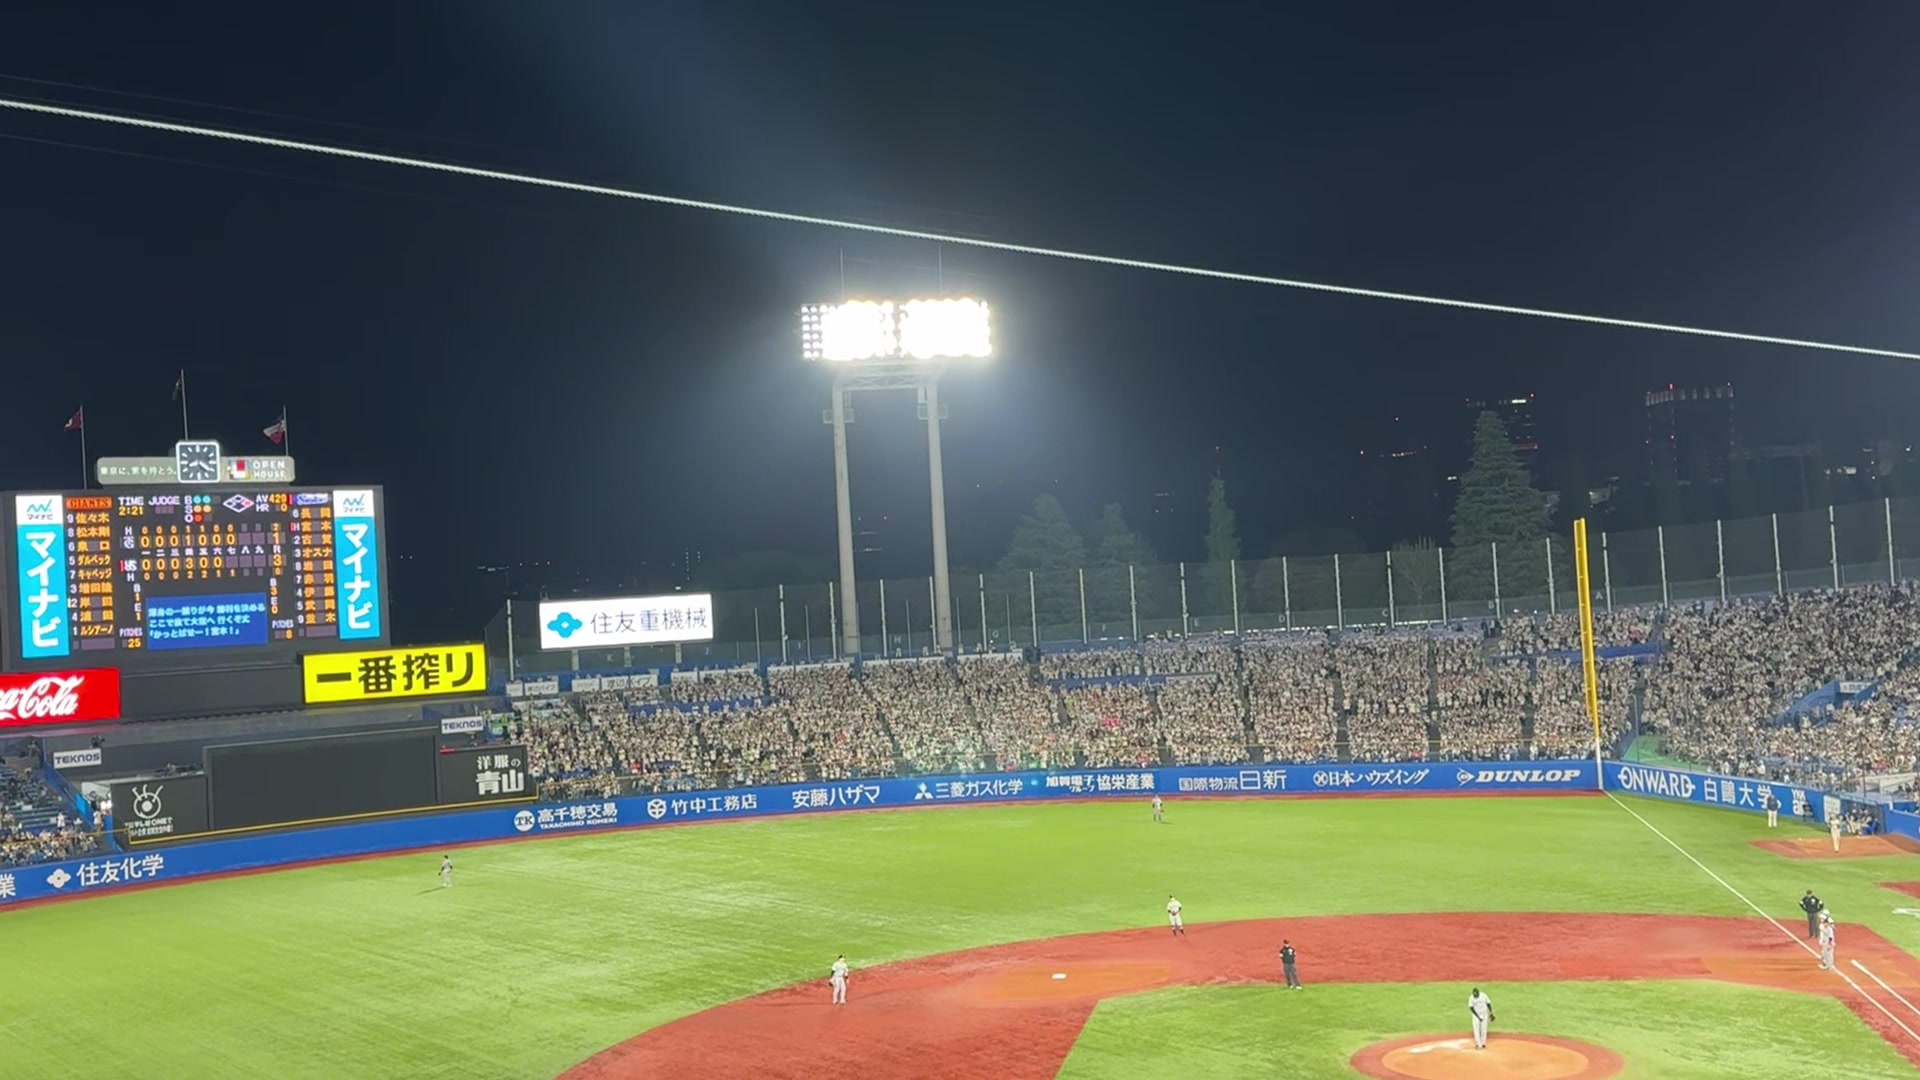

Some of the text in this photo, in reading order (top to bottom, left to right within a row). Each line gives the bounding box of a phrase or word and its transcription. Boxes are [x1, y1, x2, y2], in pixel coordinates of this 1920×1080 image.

[253, 460, 286, 469] OPEN
[253, 470, 286, 478] HOUSE
[69, 498, 109, 508] GIANTS
[118, 496, 144, 506] TIME
[148, 496, 180, 506] JUDGE
[184, 495, 193, 505] B
[256, 494, 268, 503] AV
[119, 506, 144, 516] 2:21
[256, 503, 288, 512] HR 0
[67, 514, 74, 523] 9
[292, 509, 299, 518] 6
[68, 527, 74, 537] 8
[124, 526, 132, 536] H
[141, 536, 150, 548] 0
[156, 536, 164, 547] 0
[170, 535, 178, 547] 0
[198, 534, 206, 546] 0
[212, 534, 220, 546] 0
[226, 534, 235, 546] 0
[294, 535, 300, 544] 2
[68, 542, 75, 552] 6
[170, 548, 180, 556] 三
[213, 547, 222, 555] 六
[226, 546, 236, 554] 七
[272, 545, 281, 554] R
[294, 547, 332, 558] 3 オスナ
[69, 556, 76, 566] 5
[142, 559, 150, 570] 0
[156, 558, 165, 570] 0
[171, 558, 180, 570] 0
[185, 558, 194, 570] 3
[200, 557, 208, 568] 0
[214, 556, 222, 568] 0
[273, 554, 282, 566] 3
[295, 562, 302, 571] 8
[70, 570, 76, 579] 7
[126, 572, 134, 582] H
[187, 571, 194, 580] 2
[201, 570, 208, 578] 2
[341, 523, 373, 630] マイナビ
[296, 576, 302, 584] 7
[25, 530, 62, 648] マイナビ
[70, 584, 77, 594] 3
[134, 584, 140, 593] B
[270, 586, 278, 596] 3
[296, 588, 302, 597] 4
[68, 598, 78, 608] 12
[270, 596, 278, 606] E
[297, 601, 303, 610] 5
[134, 603, 142, 612] E
[271, 605, 278, 614] 0
[72, 612, 78, 622] 4
[298, 614, 304, 624] 9
[590, 607, 708, 635] 住友重機械
[128, 638, 140, 648] 25
[316, 652, 474, 694] 一番搾り
[443, 720, 482, 730] TEKNOS
[56, 752, 100, 765] TEKNOS
[477, 754, 520, 770] 洋服の
[1046, 774, 1095, 788] 加賀電子
[1178, 769, 1288, 792] 国際物流 日新
[1328, 768, 1430, 787] 日本ハウズイング
[1475, 769, 1582, 783] DUNLOP
[476, 769, 524, 796] 青山
[1097, 773, 1155, 791] 協栄産業
[1618, 766, 1696, 798] ONWARD
[935, 778, 1023, 798] 三菱ガス化学
[792, 784, 881, 809] 安藤ハザマ
[671, 794, 758, 816] 竹中工務店
[538, 802, 618, 824] 高千穂交易
[516, 816, 533, 826] TK
[76, 853, 164, 887] 住友化学
[0, 873, 16, 899] 業
